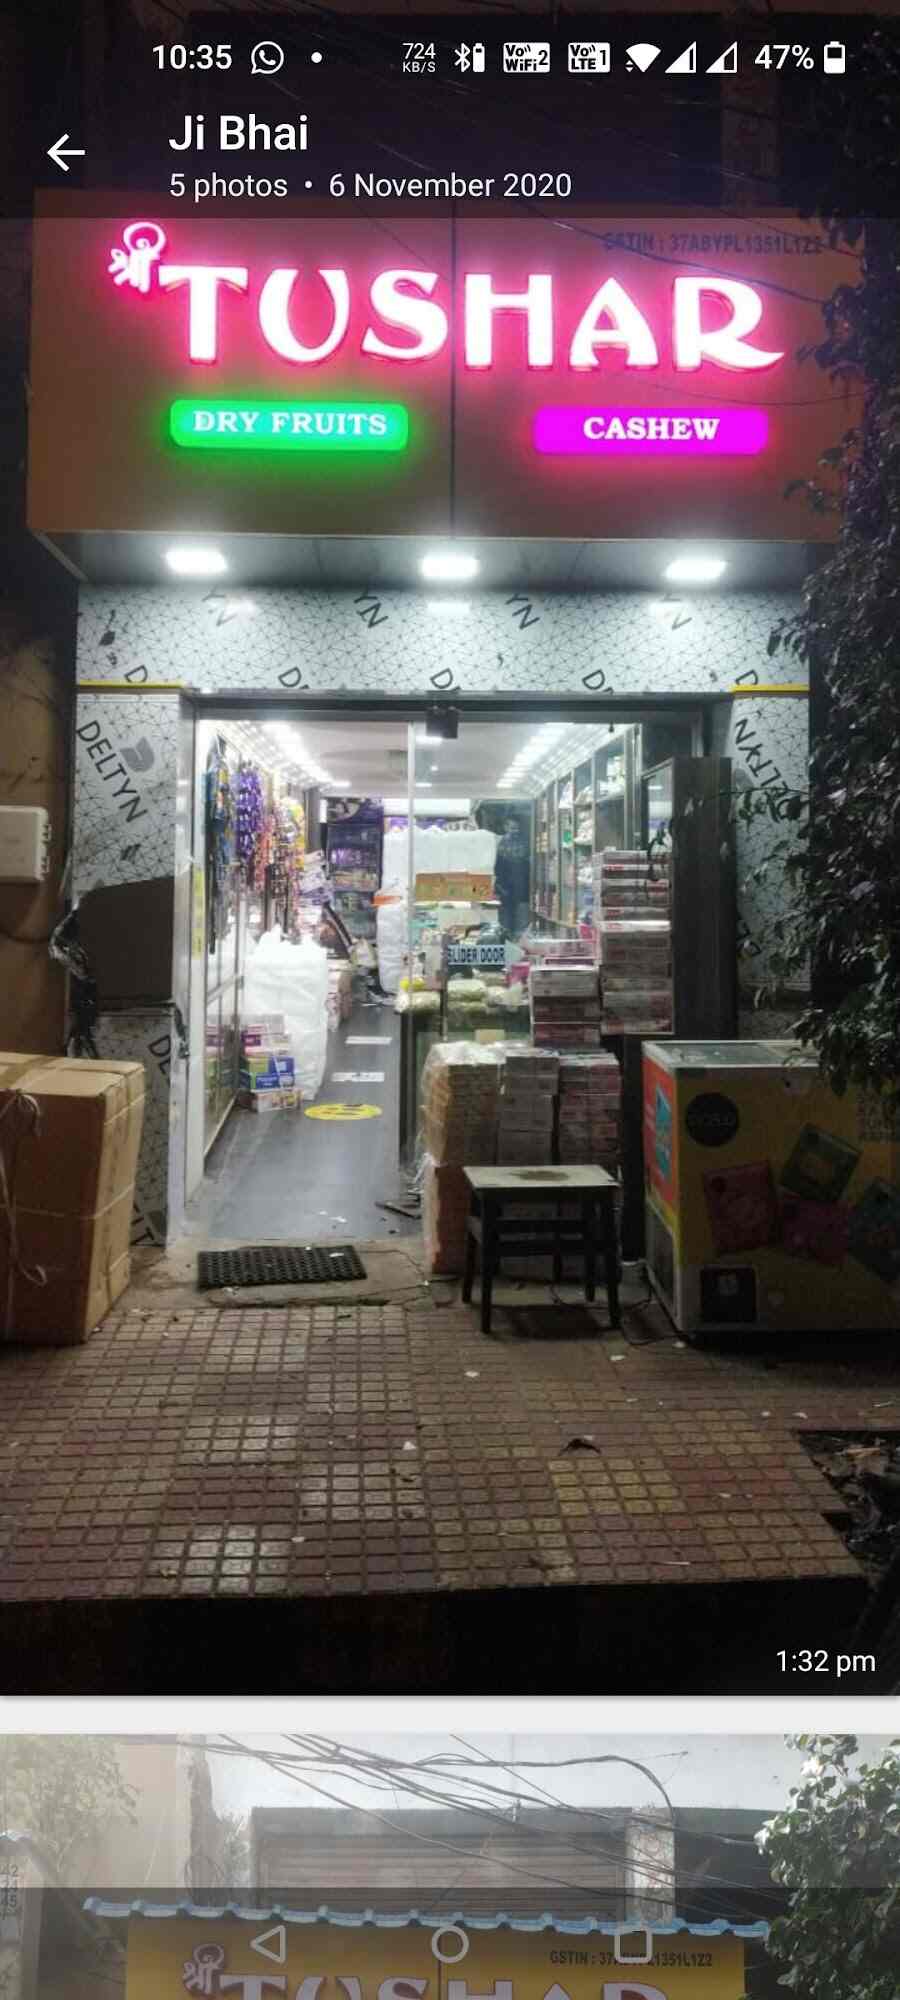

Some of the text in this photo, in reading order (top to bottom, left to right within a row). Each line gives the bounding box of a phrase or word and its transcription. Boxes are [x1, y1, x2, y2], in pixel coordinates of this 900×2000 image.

[158, 264, 785, 372] TUSHAR
[193, 411, 387, 435] DRY FRUITS
[583, 416, 720, 441] CASHEW
[76, 720, 148, 822] DELTYN
[481, 946, 505, 963] DOOR
[550, 1951, 591, 1966] GSTIN
